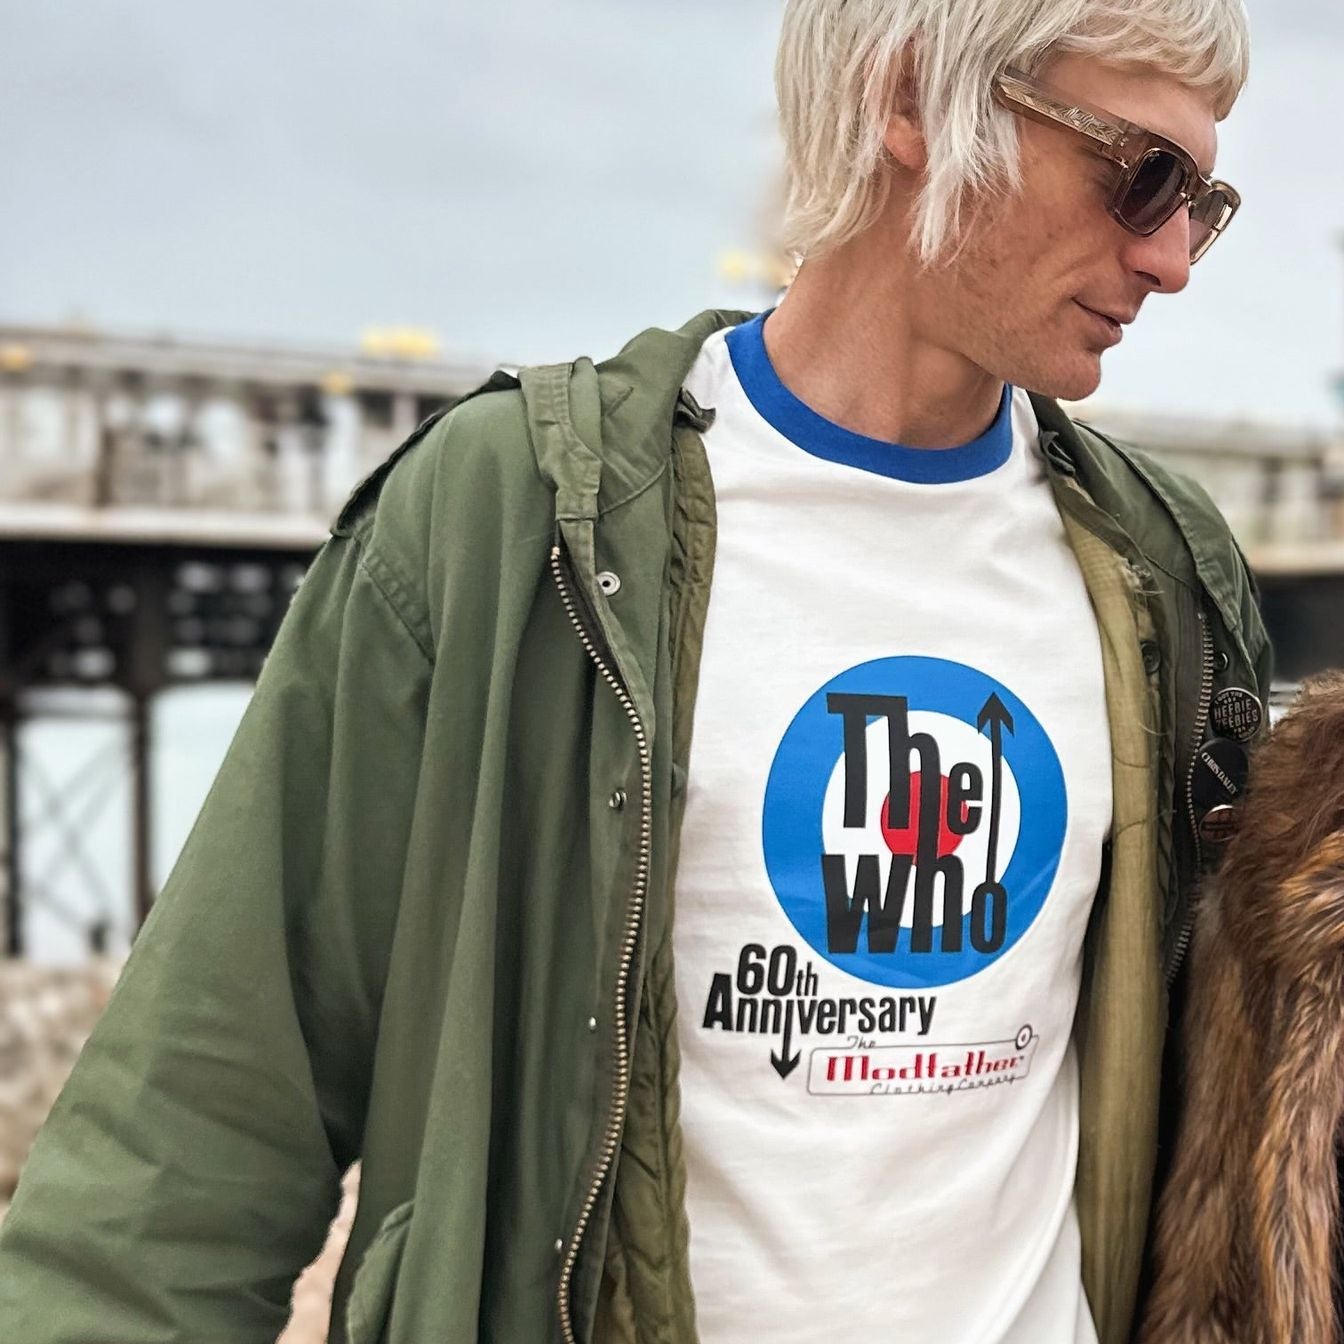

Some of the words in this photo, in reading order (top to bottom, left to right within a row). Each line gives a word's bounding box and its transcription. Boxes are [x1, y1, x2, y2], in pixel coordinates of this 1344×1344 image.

[826, 692, 984, 836] The
[736, 943, 819, 997] 60th
[702, 971, 937, 1037] Anniversary
[826, 1050, 1019, 1082] Modfather
[846, 1035, 877, 1050] The
